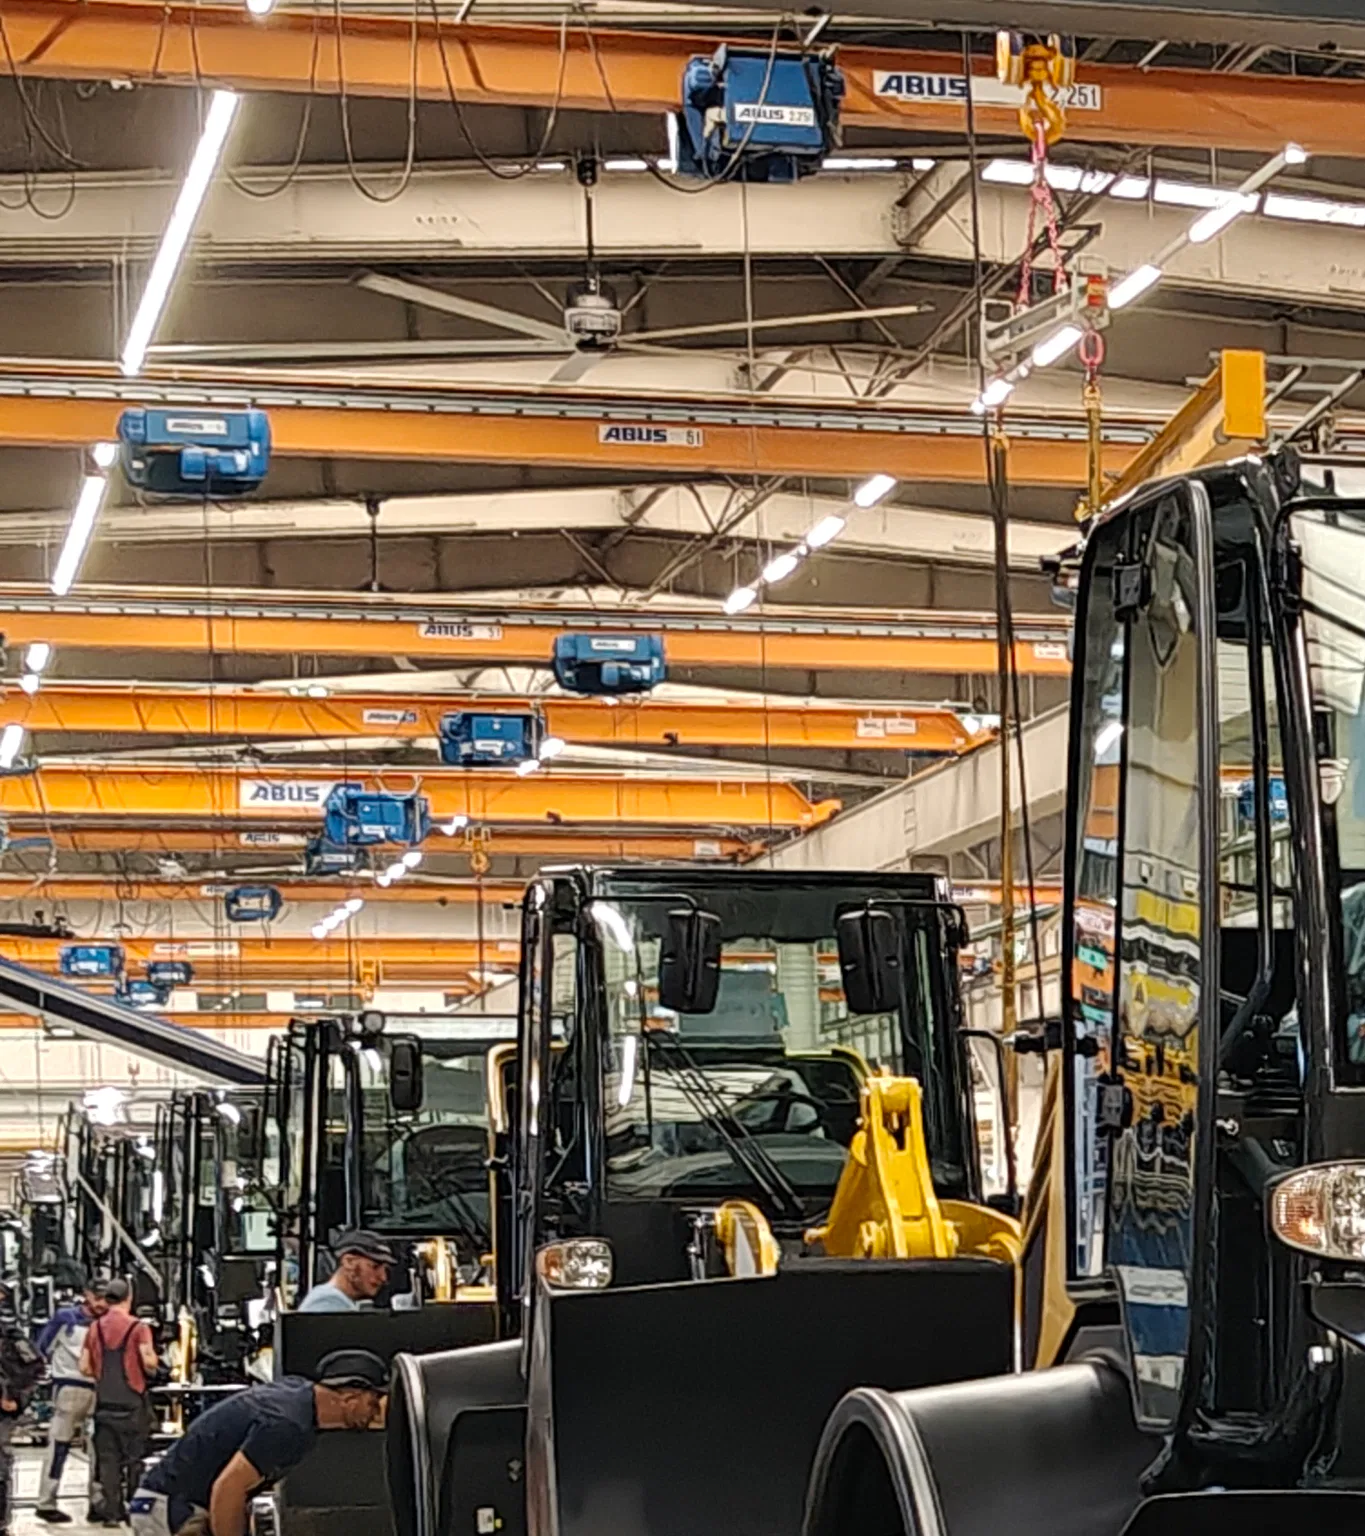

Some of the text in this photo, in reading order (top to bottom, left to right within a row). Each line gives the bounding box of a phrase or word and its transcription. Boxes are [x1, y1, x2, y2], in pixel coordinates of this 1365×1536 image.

[880, 74, 969, 97] ABUS
[604, 427, 668, 442] ABUS
[250, 785, 320, 802] ABUS
